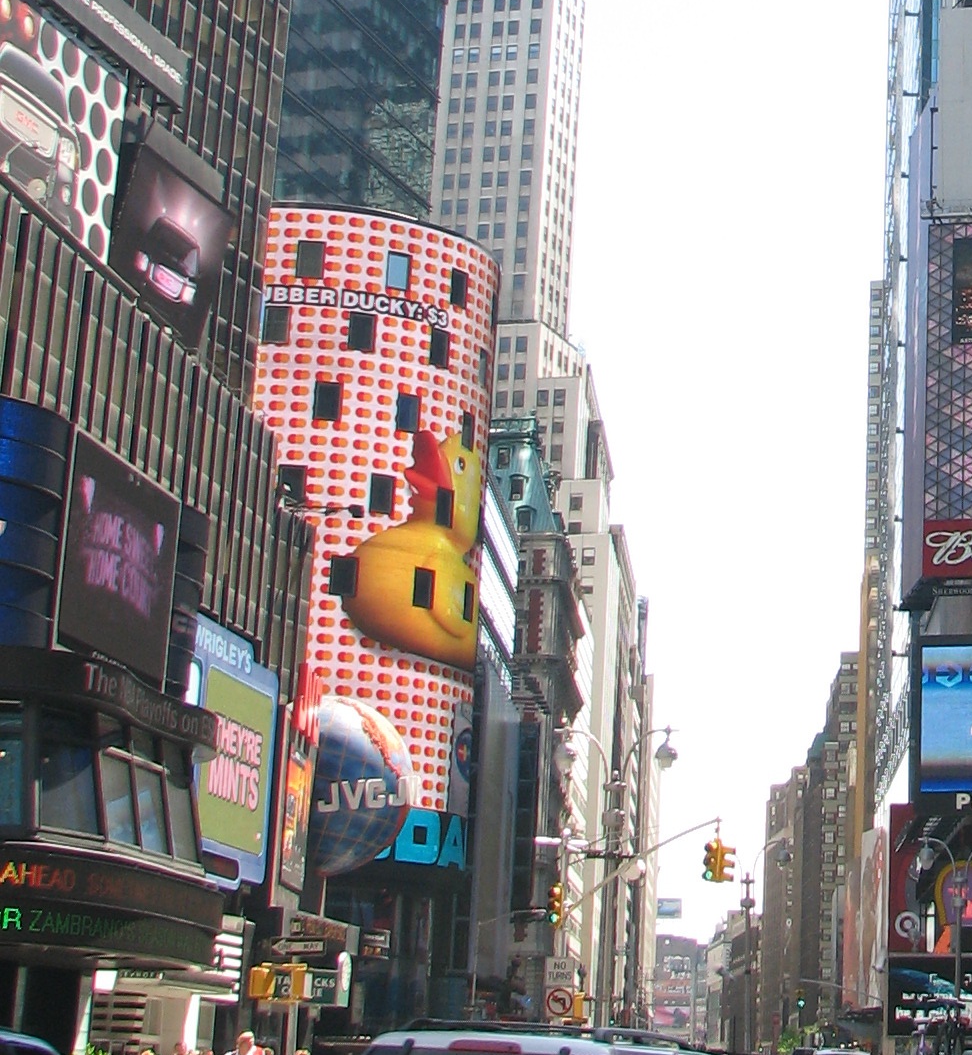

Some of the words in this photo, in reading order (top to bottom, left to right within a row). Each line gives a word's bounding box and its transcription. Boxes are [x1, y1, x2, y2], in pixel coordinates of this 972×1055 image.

[91, 2, 153, 60] PROFESSIONAL
[343, 292, 423, 320] DUCKY:
[427, 306, 448, 327] $3
[195, 625, 253, 674] WRIGLEY'S
[85, 662, 117, 696] The
[182, 713, 199, 734] on
[217, 713, 263, 767] THEY'RE
[207, 756, 260, 811] MINTS
[317, 777, 387, 813] JVC
[376, 807, 467, 871] DA
[0, 862, 76, 891] AHEAD
[0, 907, 22, 931] R
[549, 971, 572, 981] TURNS
[554, 961, 567, 970] NO
